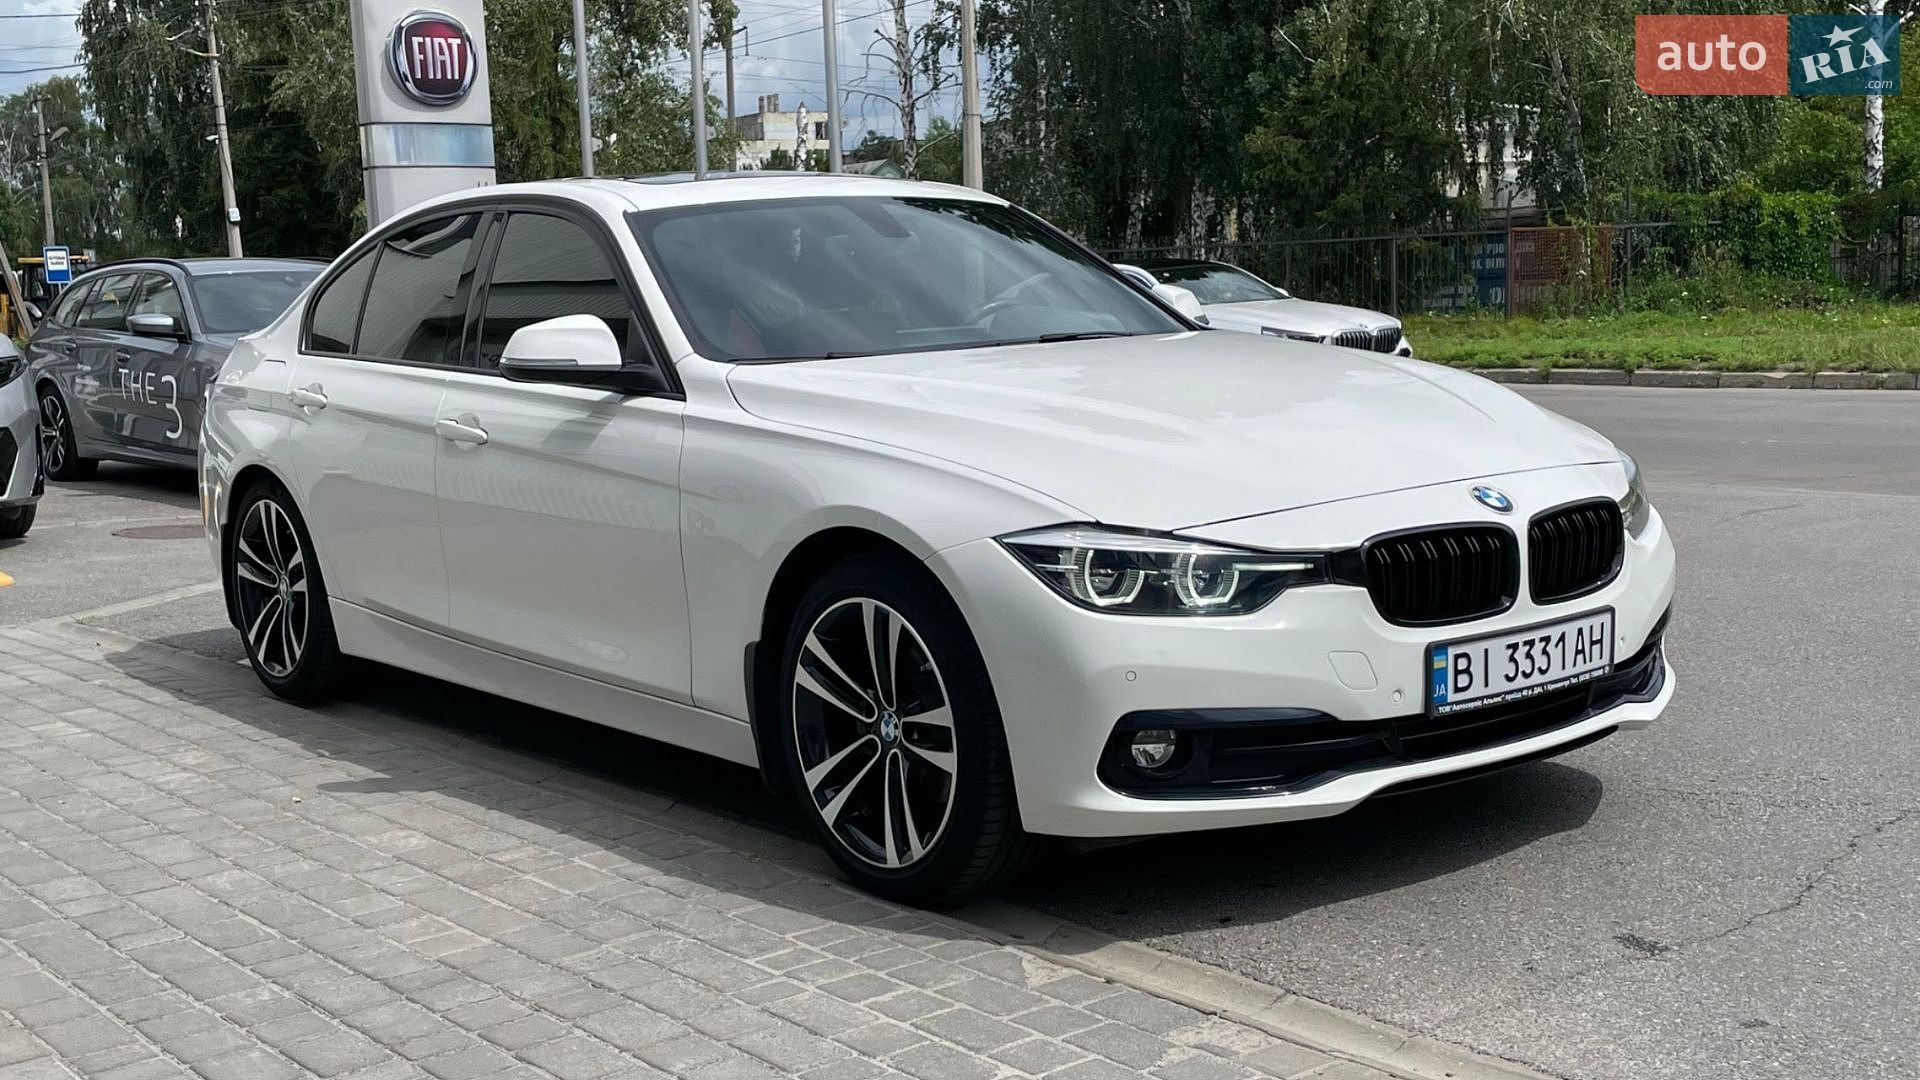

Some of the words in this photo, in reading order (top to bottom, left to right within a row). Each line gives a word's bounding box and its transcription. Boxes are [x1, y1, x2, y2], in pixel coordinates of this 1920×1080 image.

[411, 36, 462, 80] FIAT
[118, 367, 158, 405] THE
[161, 374, 183, 439] 3
[1453, 648, 1489, 694] BI
